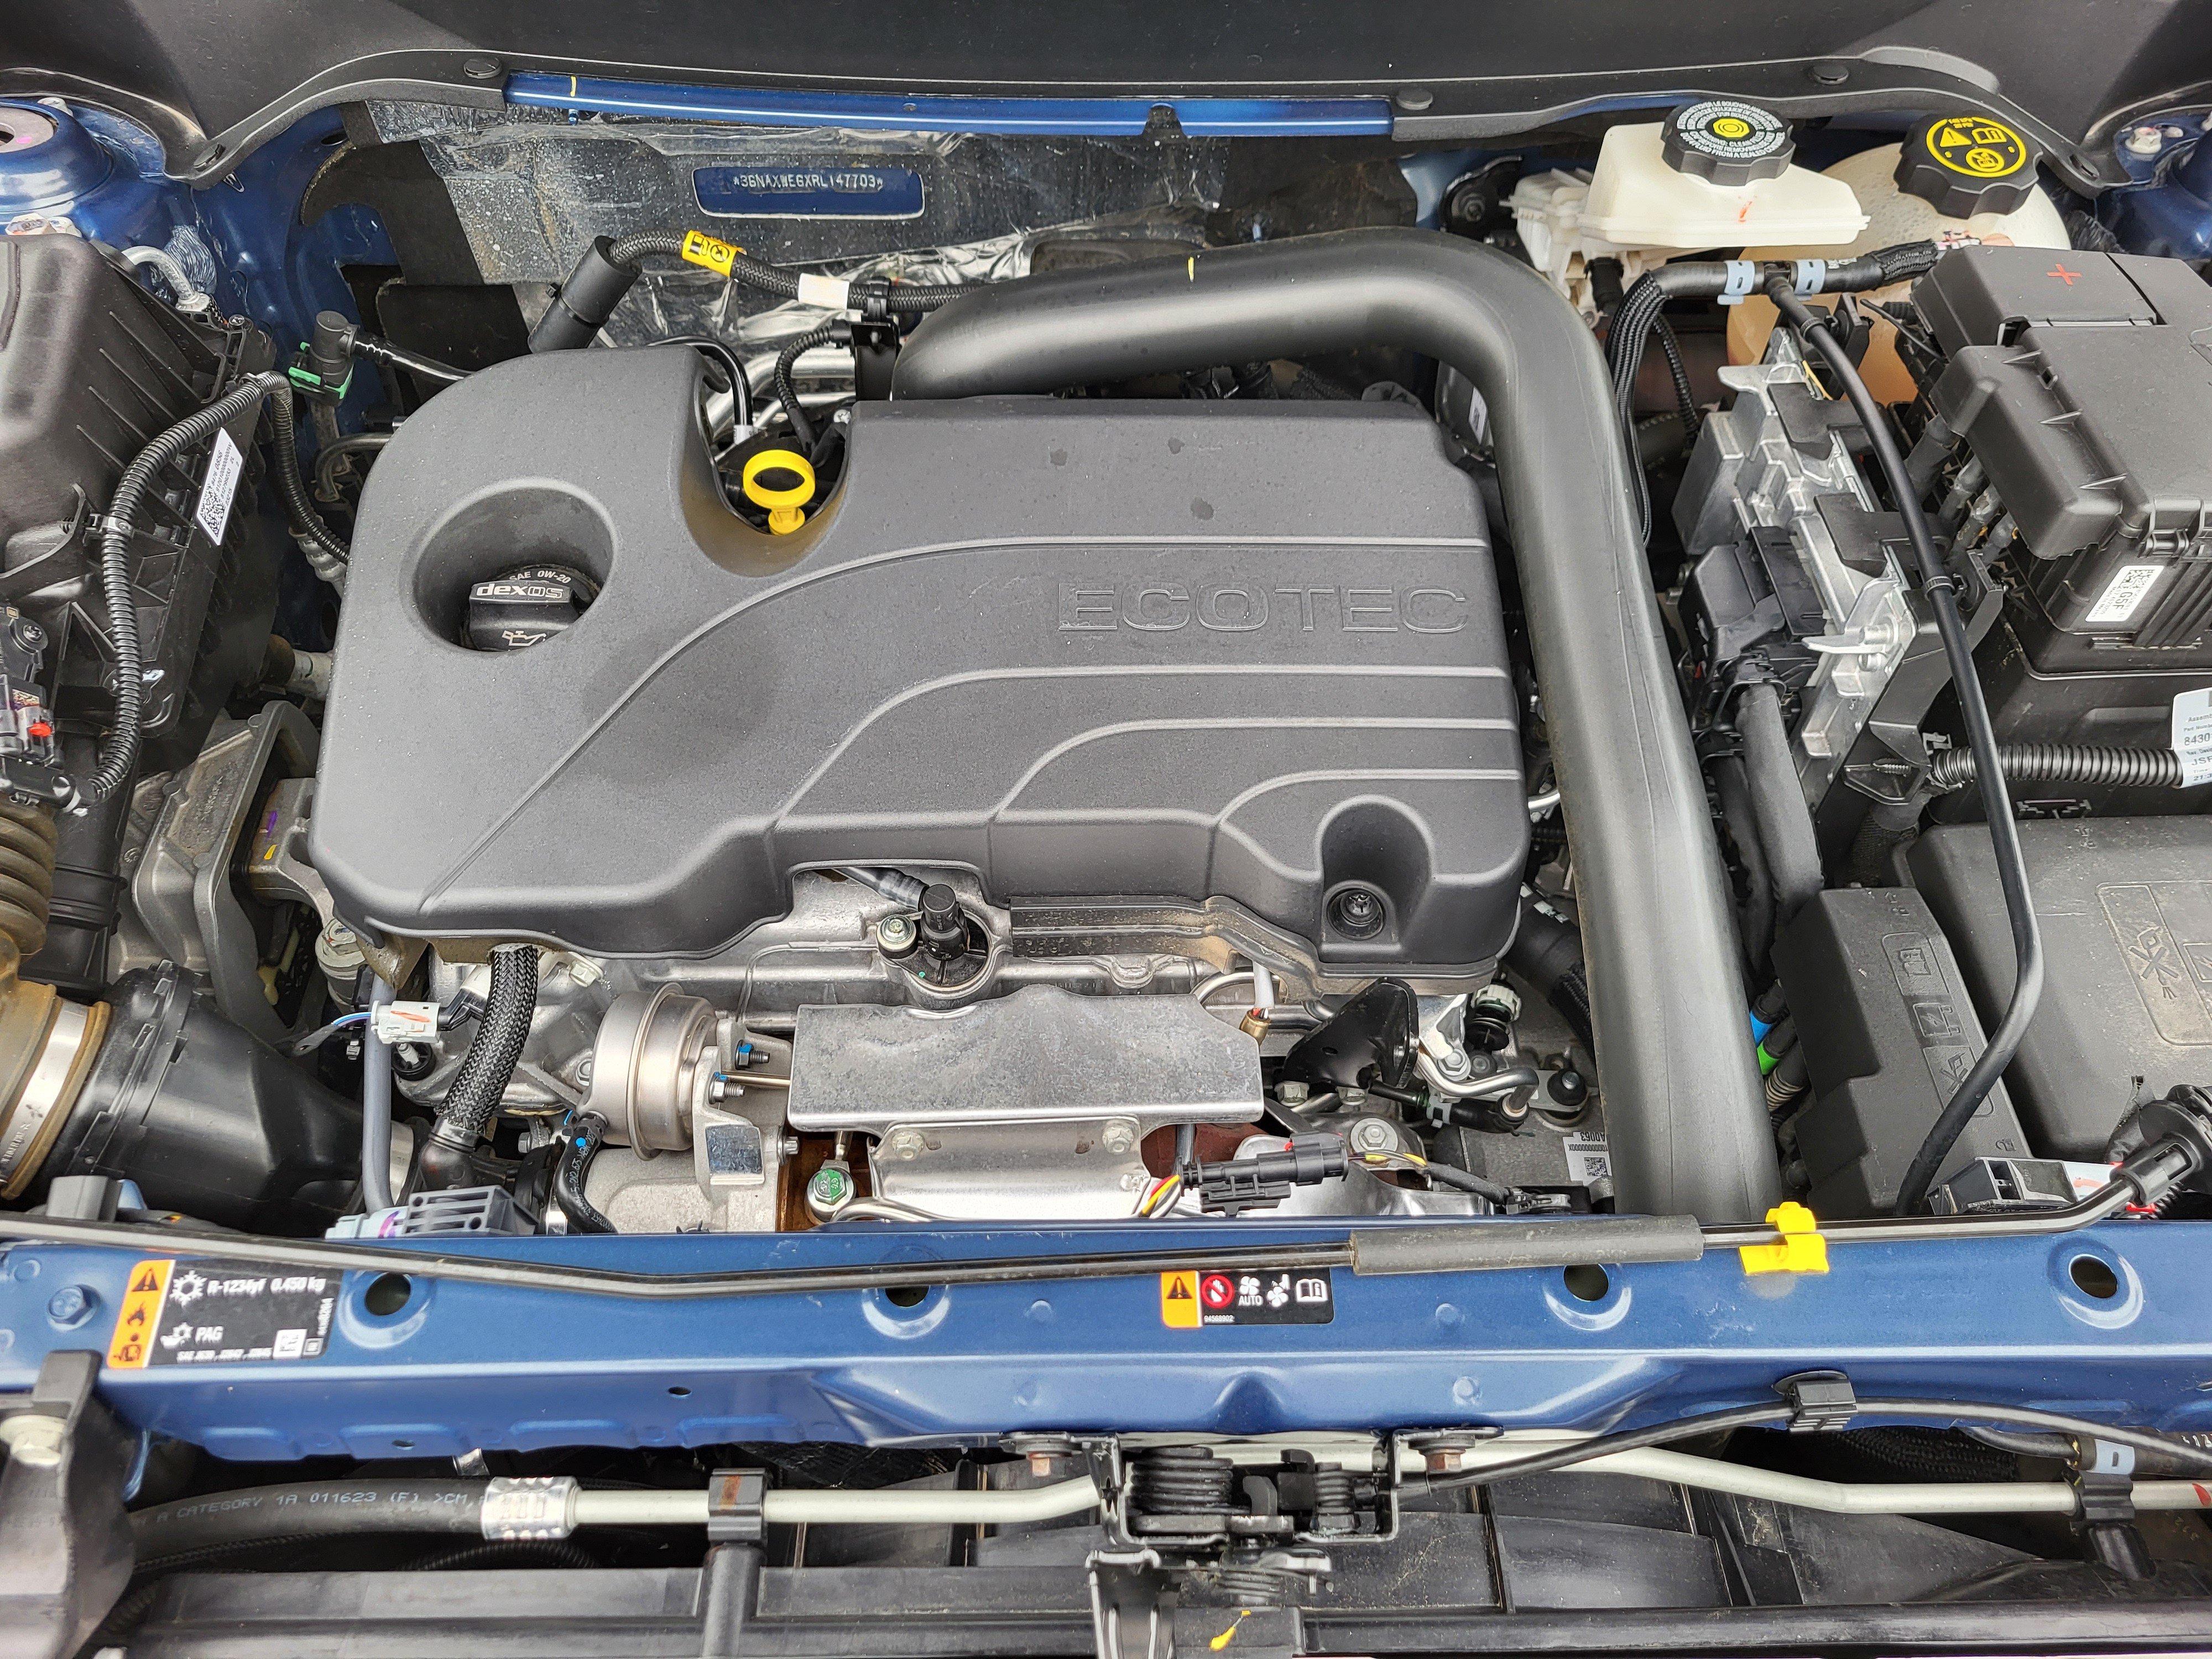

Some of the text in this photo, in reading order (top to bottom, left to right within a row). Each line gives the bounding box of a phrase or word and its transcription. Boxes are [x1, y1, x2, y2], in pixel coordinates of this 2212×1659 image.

[509, 570, 572, 584] SAE 0W-20
[476, 583, 564, 599] dexos
[1057, 581, 1469, 633] ECOTEC
[2112, 592, 2133, 610] G5F
[2184, 732, 2212, 747] 8430
[1579, 1131, 1605, 1142] A0063
[207, 1277, 268, 1297] R-1234yf
[307, 1276, 327, 1294] kg
[1238, 1295, 1264, 1307] AUTO
[1204, 1314, 1235, 1323] 94568902
[195, 1326, 224, 1343] PAG
[176, 1496, 264, 1518] CATEGORY
[276, 1494, 298, 1505] 1A
[309, 1491, 377, 1504] 011623
